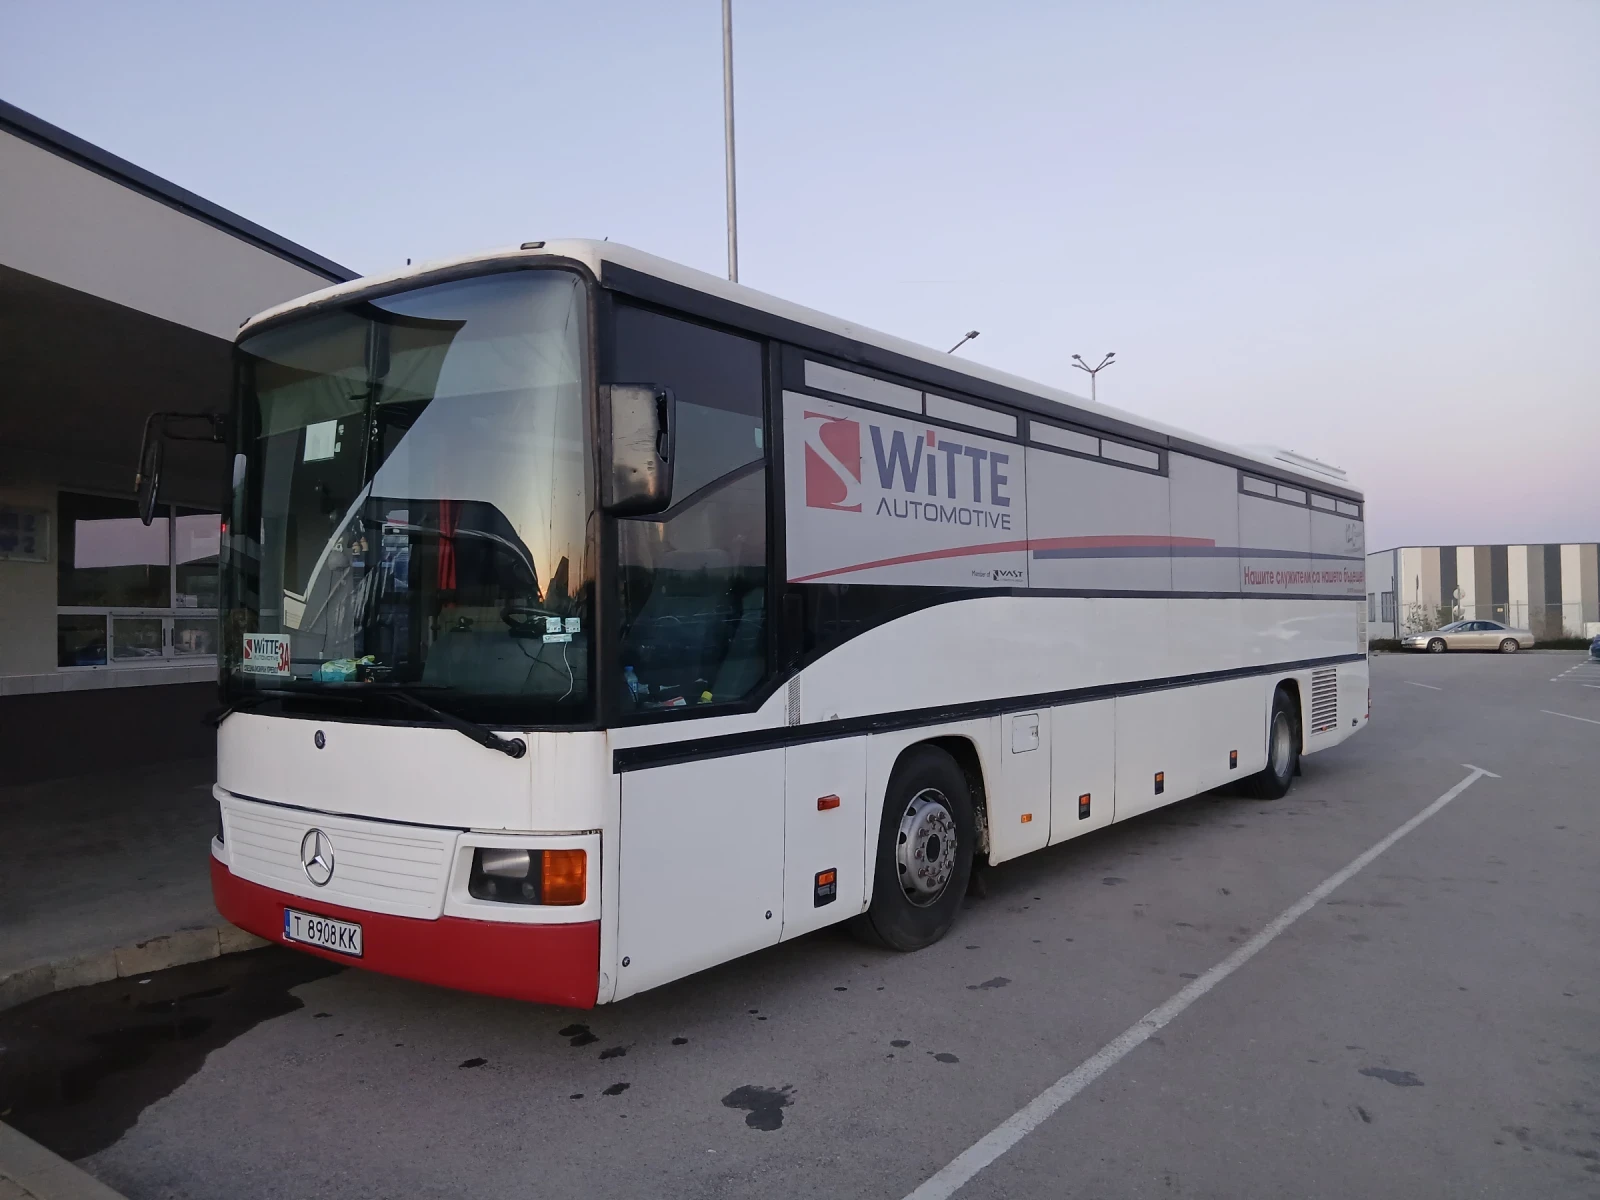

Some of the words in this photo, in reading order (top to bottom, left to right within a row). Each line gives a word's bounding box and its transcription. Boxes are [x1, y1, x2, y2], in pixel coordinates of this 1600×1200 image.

[869, 425, 1011, 508] WiTTE
[876, 497, 1011, 531] AUTOMOTIVE
[1244, 566, 1274, 585] Нашите
[1276, 570, 1312, 589] служители
[1312, 572, 1320, 583] са
[1321, 571, 1342, 583] нашето
[294, 916, 301, 936] T
